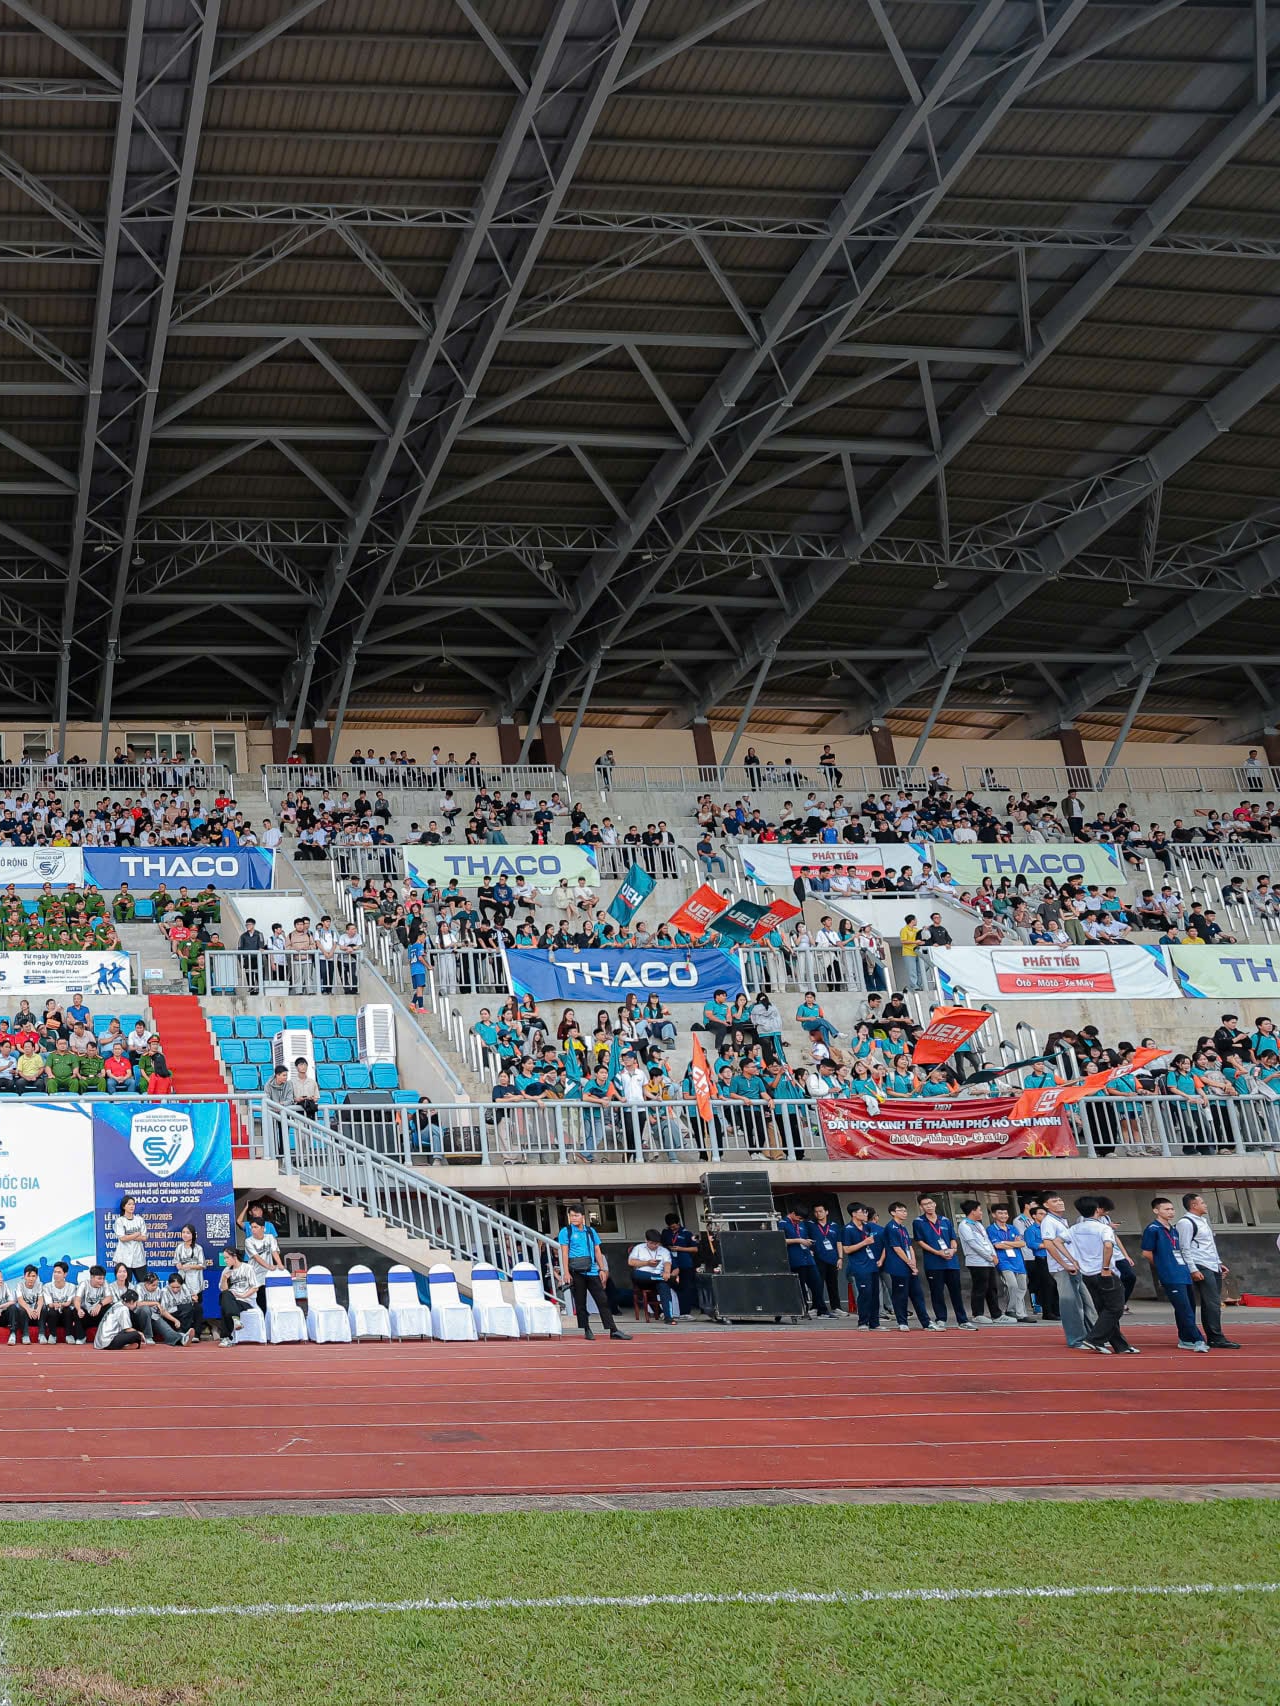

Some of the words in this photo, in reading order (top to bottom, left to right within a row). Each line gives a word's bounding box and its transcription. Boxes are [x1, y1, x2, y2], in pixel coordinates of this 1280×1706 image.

[7, 858, 28, 868] RỘNG
[812, 852, 836, 860] PHÁT
[837, 851, 858, 860] TIẾN
[972, 854, 1085, 873] THACO
[120, 856, 239, 877] THACO
[443, 855, 561, 876] THACO
[621, 883, 643, 906] UEH
[728, 910, 758, 929] UEH
[1023, 956, 1054, 967] PHÁT
[1054, 954, 1080, 967] TIẾN
[553, 961, 698, 987] THACO
[1016, 977, 1032, 987] Ôtô
[927, 1023, 970, 1040] UEH
[828, 1119, 849, 1131] ĐẠI
[851, 1120, 877, 1132] HỌC
[877, 1119, 906, 1130] KINH
[908, 1117, 923, 1129] TẾ
[924, 1118, 965, 1129] THÀNH
[966, 1116, 991, 1129] PHỐ
[992, 1116, 1009, 1128] HỒ
[1033, 1116, 1062, 1127] MINH
[20, 1177, 40, 1190] GIA
